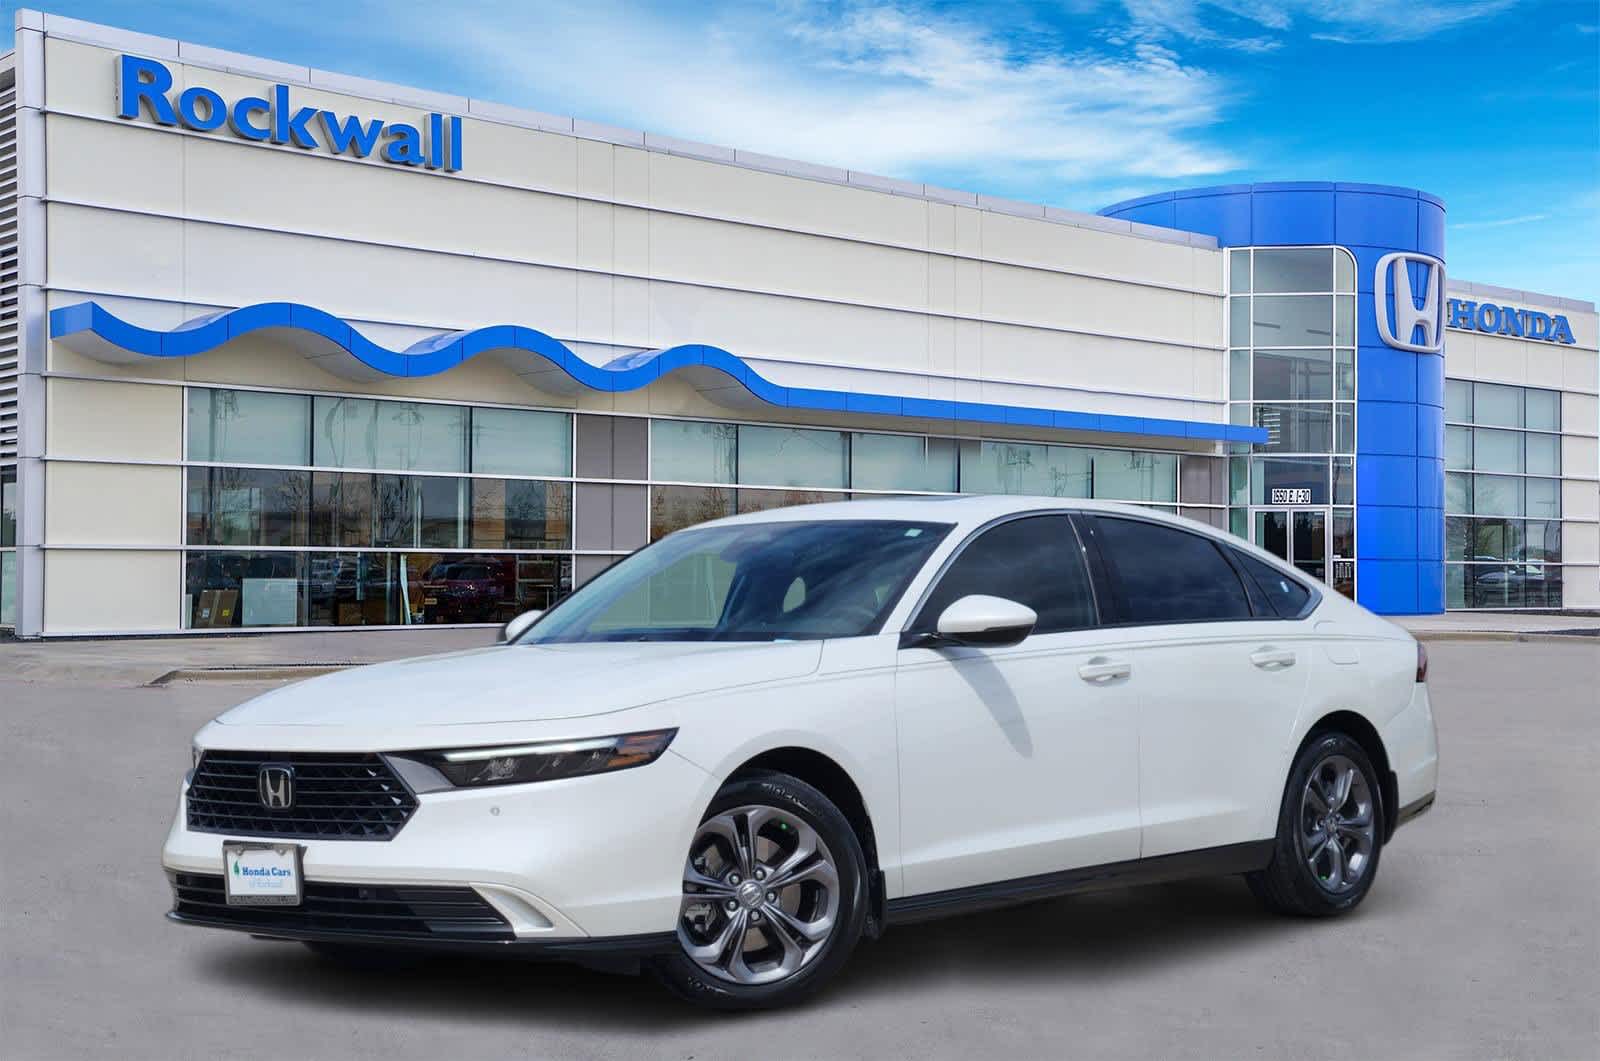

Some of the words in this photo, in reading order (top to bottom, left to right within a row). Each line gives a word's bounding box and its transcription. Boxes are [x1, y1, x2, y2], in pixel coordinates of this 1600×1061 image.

[115, 53, 464, 173] Rockwall
[1447, 298, 1577, 345] HONDA
[1273, 490, 1287, 503] 1550
[242, 866, 270, 877] Honda
[271, 866, 291, 877] Cars
